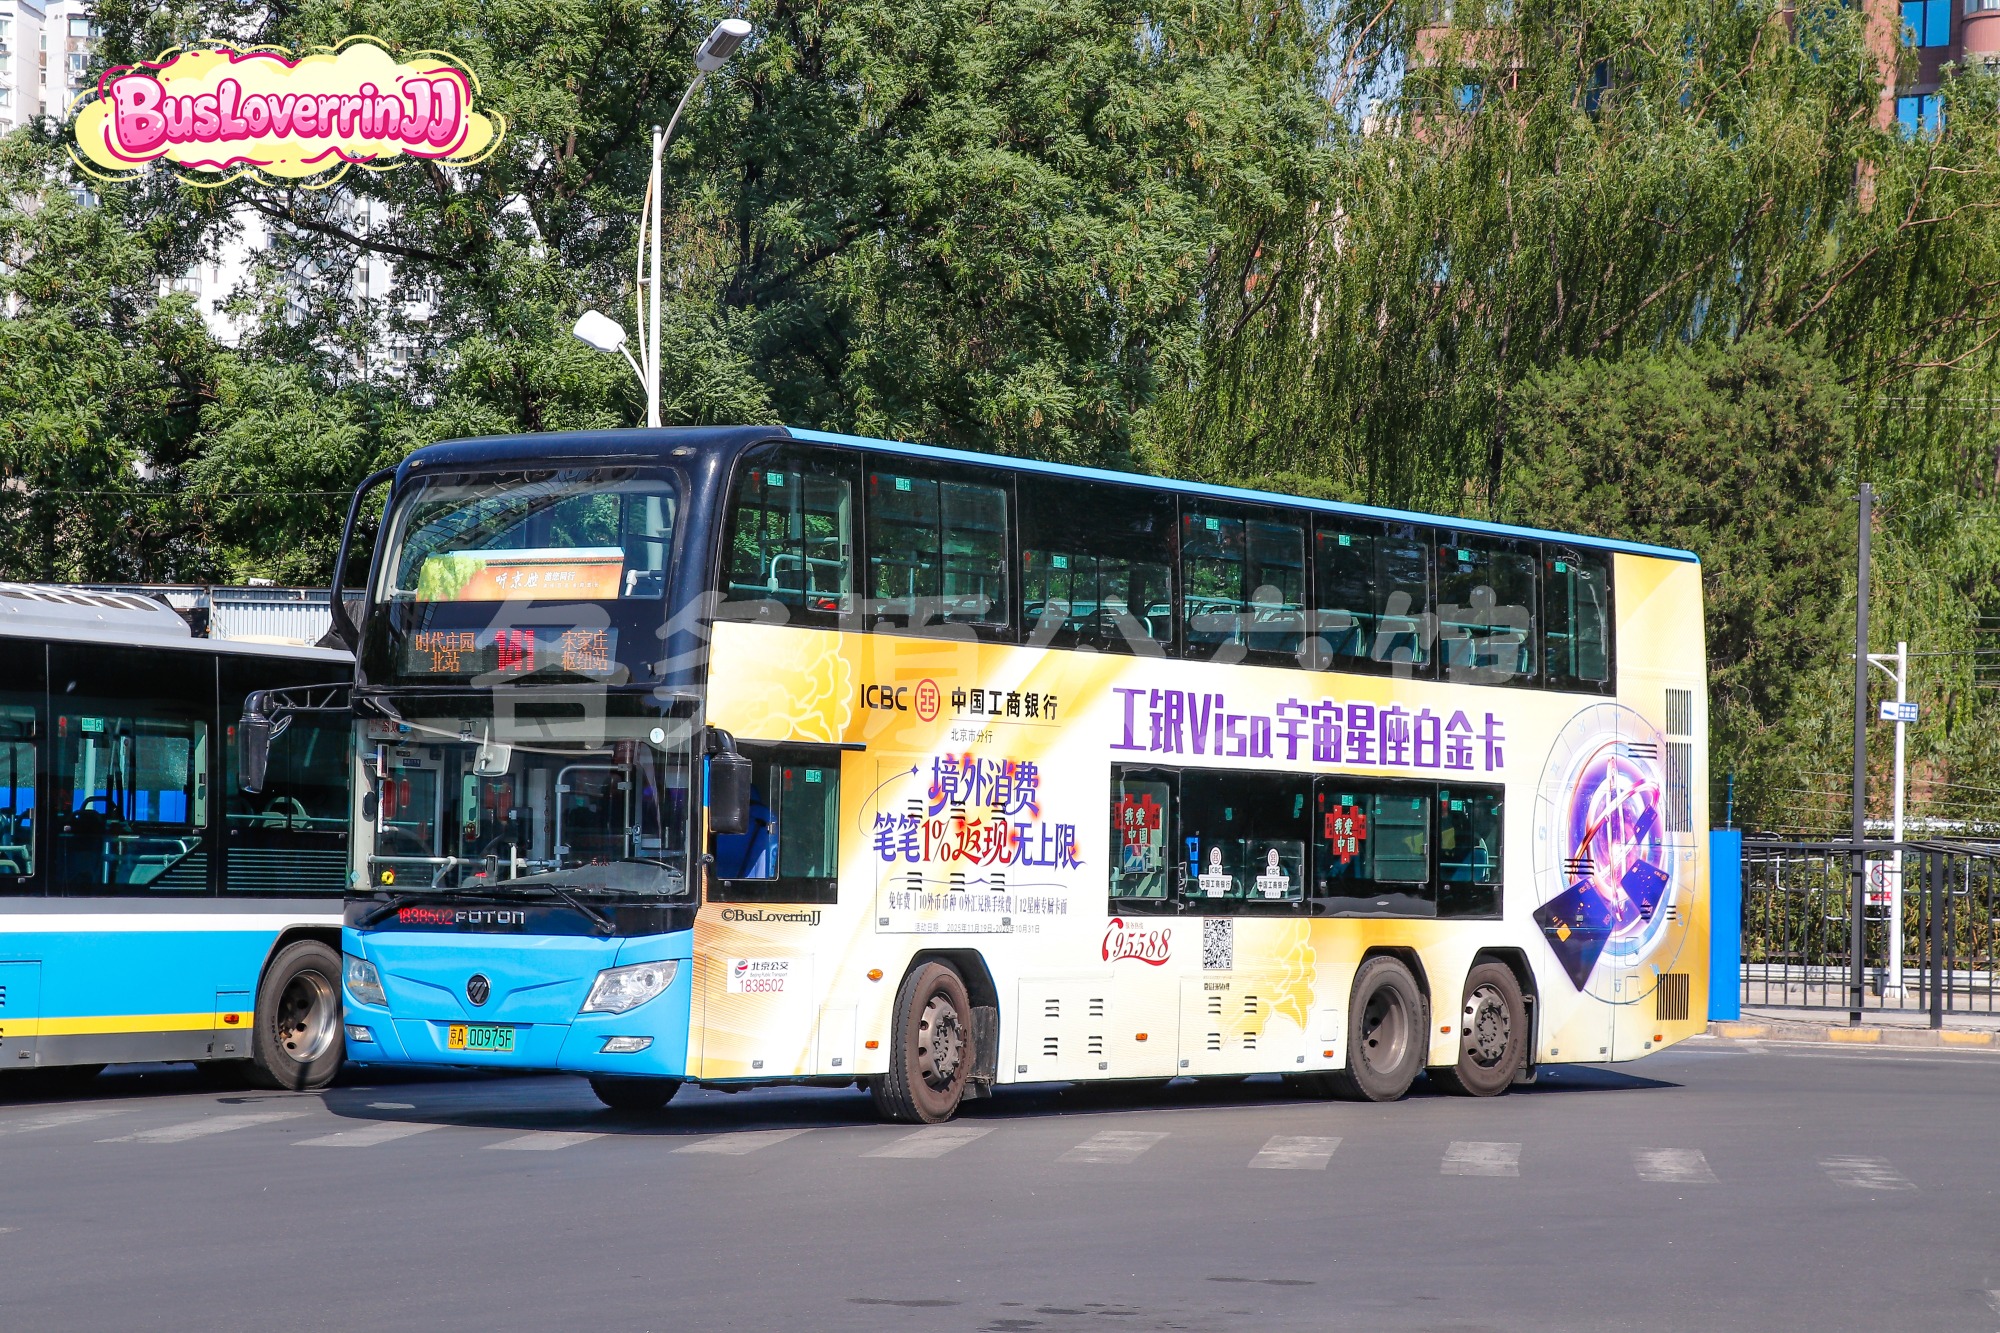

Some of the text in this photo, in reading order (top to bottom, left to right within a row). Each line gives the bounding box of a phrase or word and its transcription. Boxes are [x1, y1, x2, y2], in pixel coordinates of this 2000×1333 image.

[544, 572, 576, 581] 邀您同行
[415, 631, 475, 653] 时代庄园
[561, 630, 608, 651] 宋家庄
[495, 630, 534, 671] 141
[430, 652, 460, 672] 北站
[561, 650, 608, 671] 枢纽站
[860, 684, 908, 711] ICBC
[951, 686, 1058, 721] 中国工商银行
[951, 728, 993, 743] 北京市分行
[1110, 688, 1505, 771] 工银Visa宇宙星座白金卡
[927, 753, 1040, 817] 境外消费
[873, 812, 1087, 871] 笔笔1%返现无上限
[1209, 866, 1221, 874] ICBC
[1267, 867, 1279, 875] ICBC
[1200, 880, 1231, 889] 中国工商银行
[1258, 881, 1288, 890] 中国工商银行
[397, 907, 454, 925] 1838502
[456, 910, 525, 924] FOTON
[915, 923, 939, 932] 活动日期
[1112, 928, 1172, 958] 95588
[751, 961, 789, 971] 北京公交
[740, 979, 784, 993] 1838502
